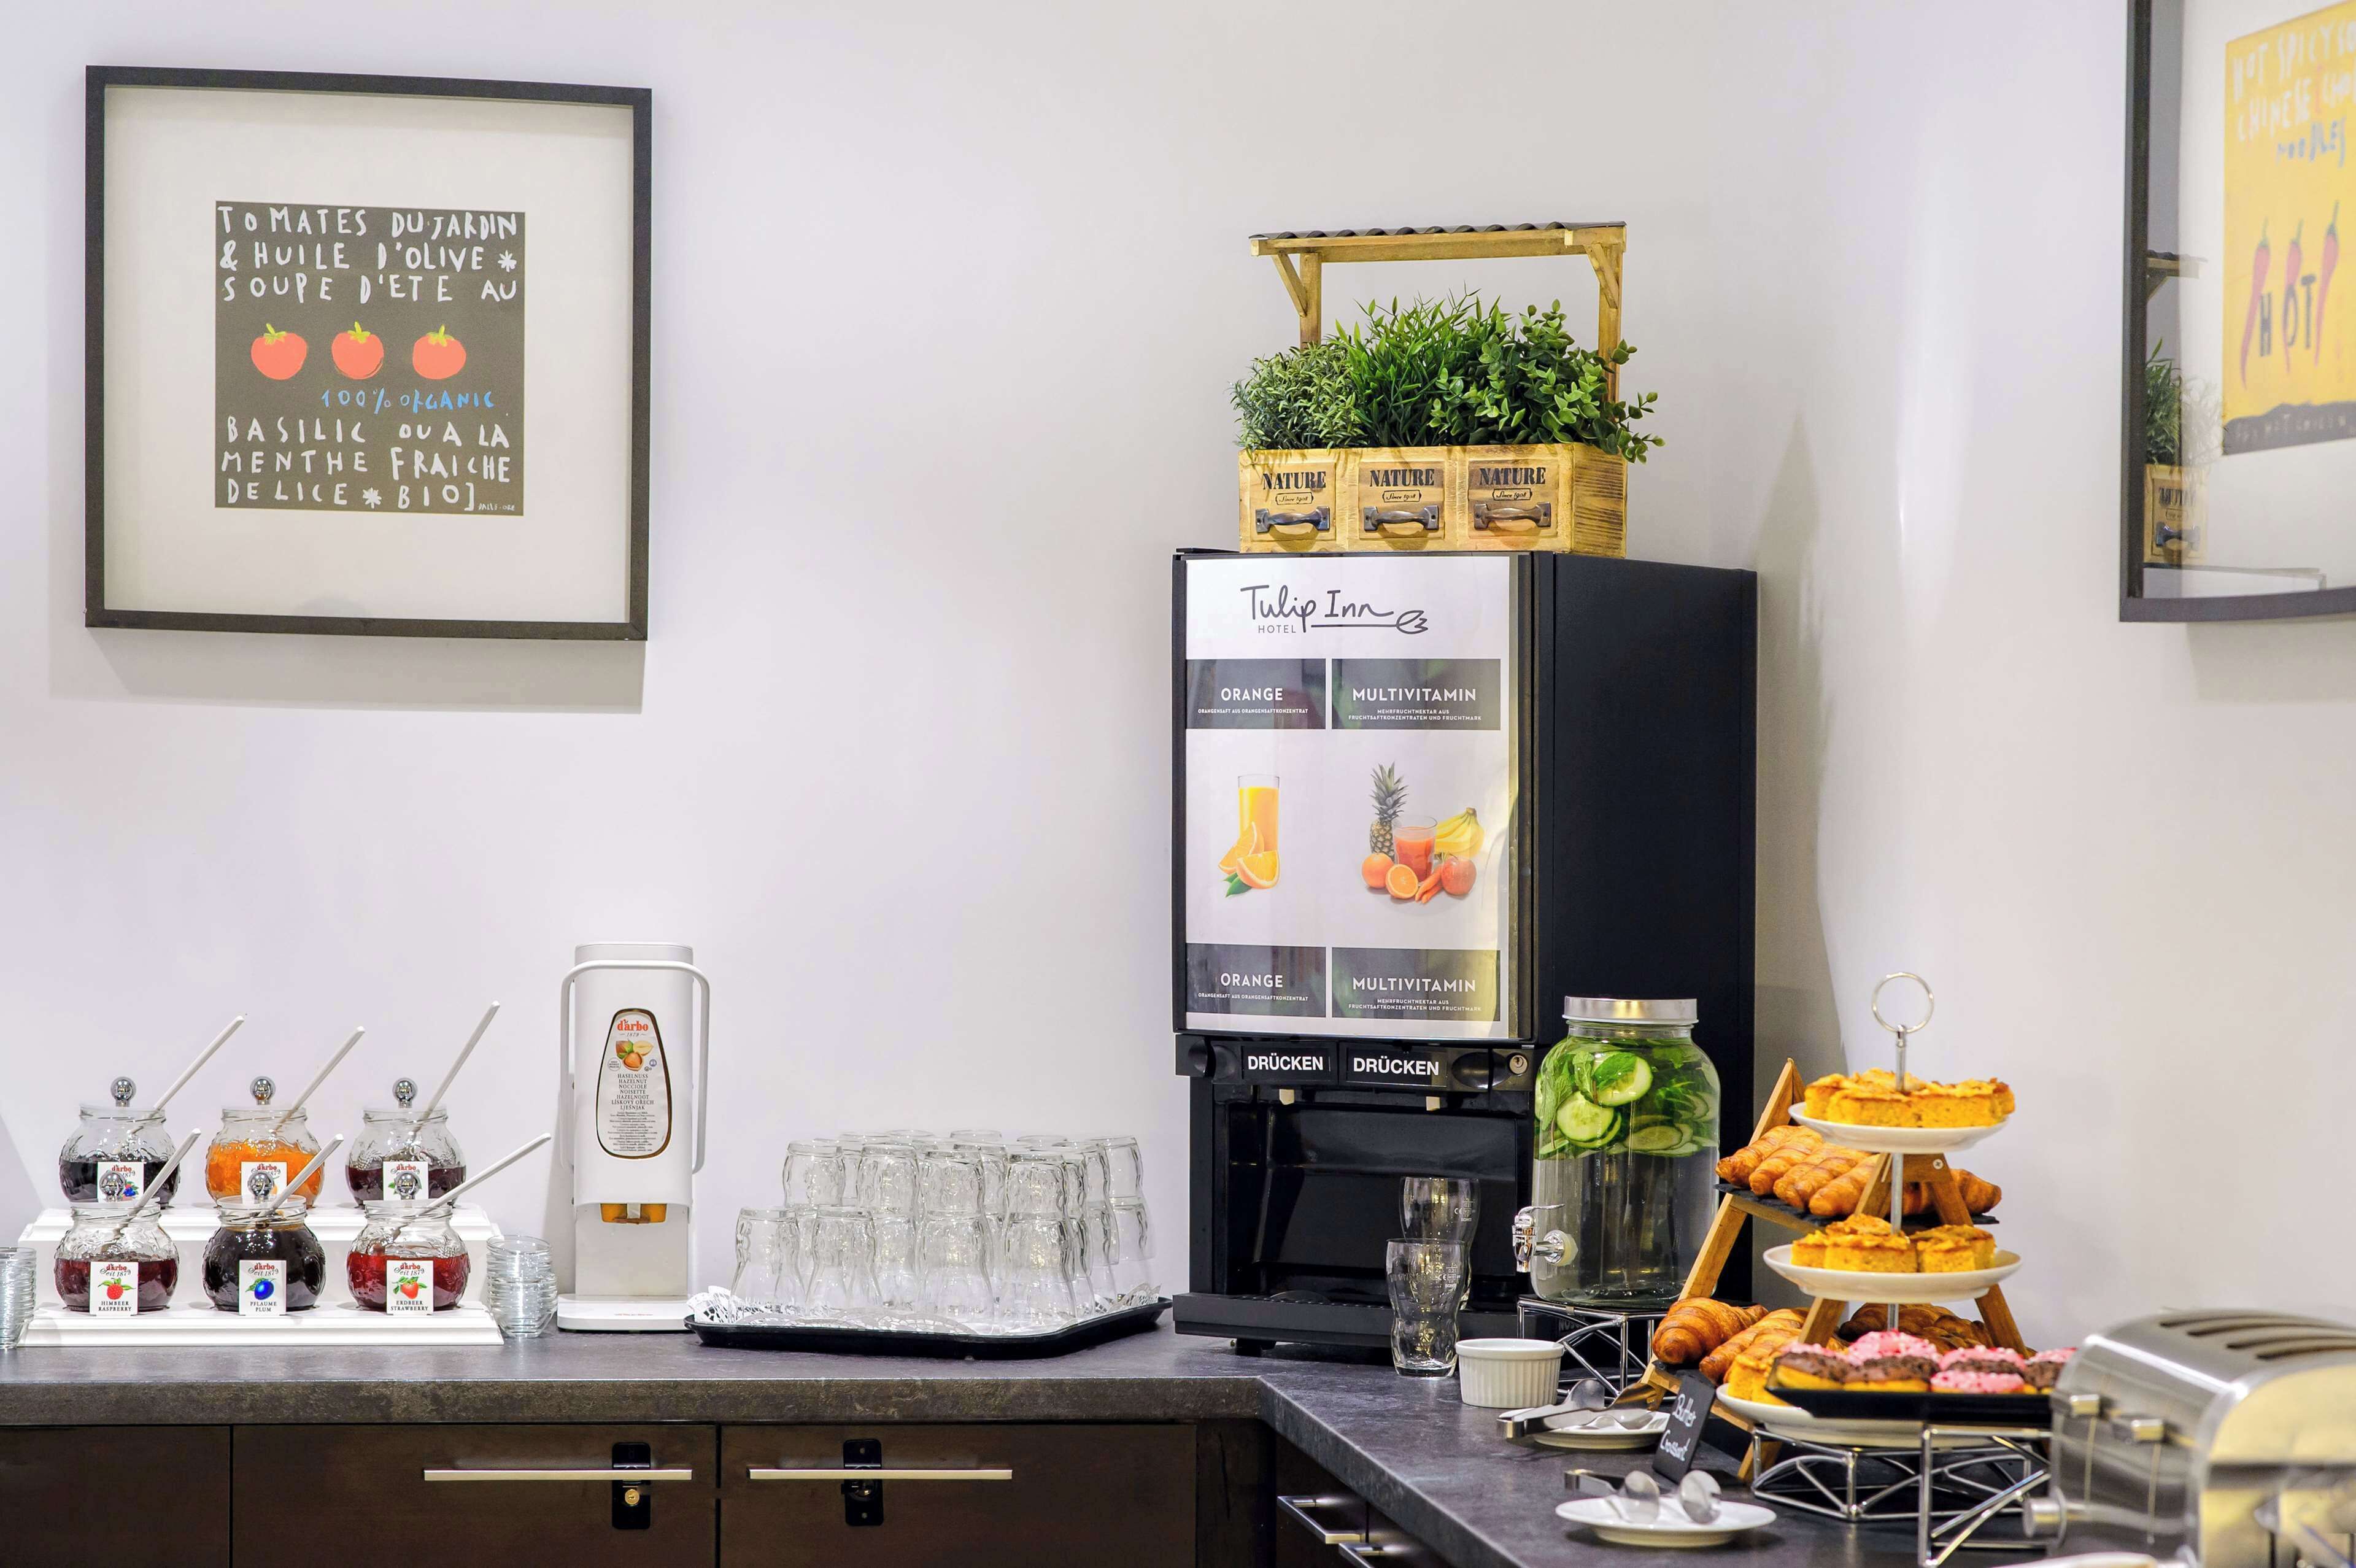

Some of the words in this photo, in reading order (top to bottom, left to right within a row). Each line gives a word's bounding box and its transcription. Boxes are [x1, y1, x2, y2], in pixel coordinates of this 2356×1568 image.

[217, 206, 367, 237] TOMATES
[219, 239, 238, 271] &
[253, 241, 350, 269] HUILE
[377, 241, 484, 272] D'OLIVE
[223, 272, 333, 303] SOUPE
[481, 279, 517, 302] AU
[2260, 274, 2317, 358] HOT
[320, 387, 392, 414] 100%
[400, 388, 495, 414] ORGANIC
[227, 415, 366, 443] BASILIC
[221, 450, 368, 475] MENTHE
[390, 447, 511, 483] FRAICHE
[1262, 471, 1326, 490] NATURE
[1369, 468, 1435, 487] NATURE
[1479, 466, 1546, 485] NATURE
[227, 477, 347, 505] DELICE
[1240, 584, 1316, 633] Tulip
[1324, 589, 1394, 617] Inn
[1258, 624, 1297, 634] HOTEL
[1221, 687, 1283, 701] ORANGE
[1353, 687, 1477, 701] MULTIVITAMIN
[1221, 972, 1283, 988] ORANGE
[1353, 976, 1476, 992] MULTIVITAMIN
[1247, 1052, 1323, 1071] DRÜCKEN
[1353, 1055, 1439, 1075] DRÜCKEN
[99, 1268, 116, 1276] Seit
[247, 1267, 264, 1276] Seit
[265, 1268, 279, 1276] 1879
[393, 1267, 409, 1276] Seit
